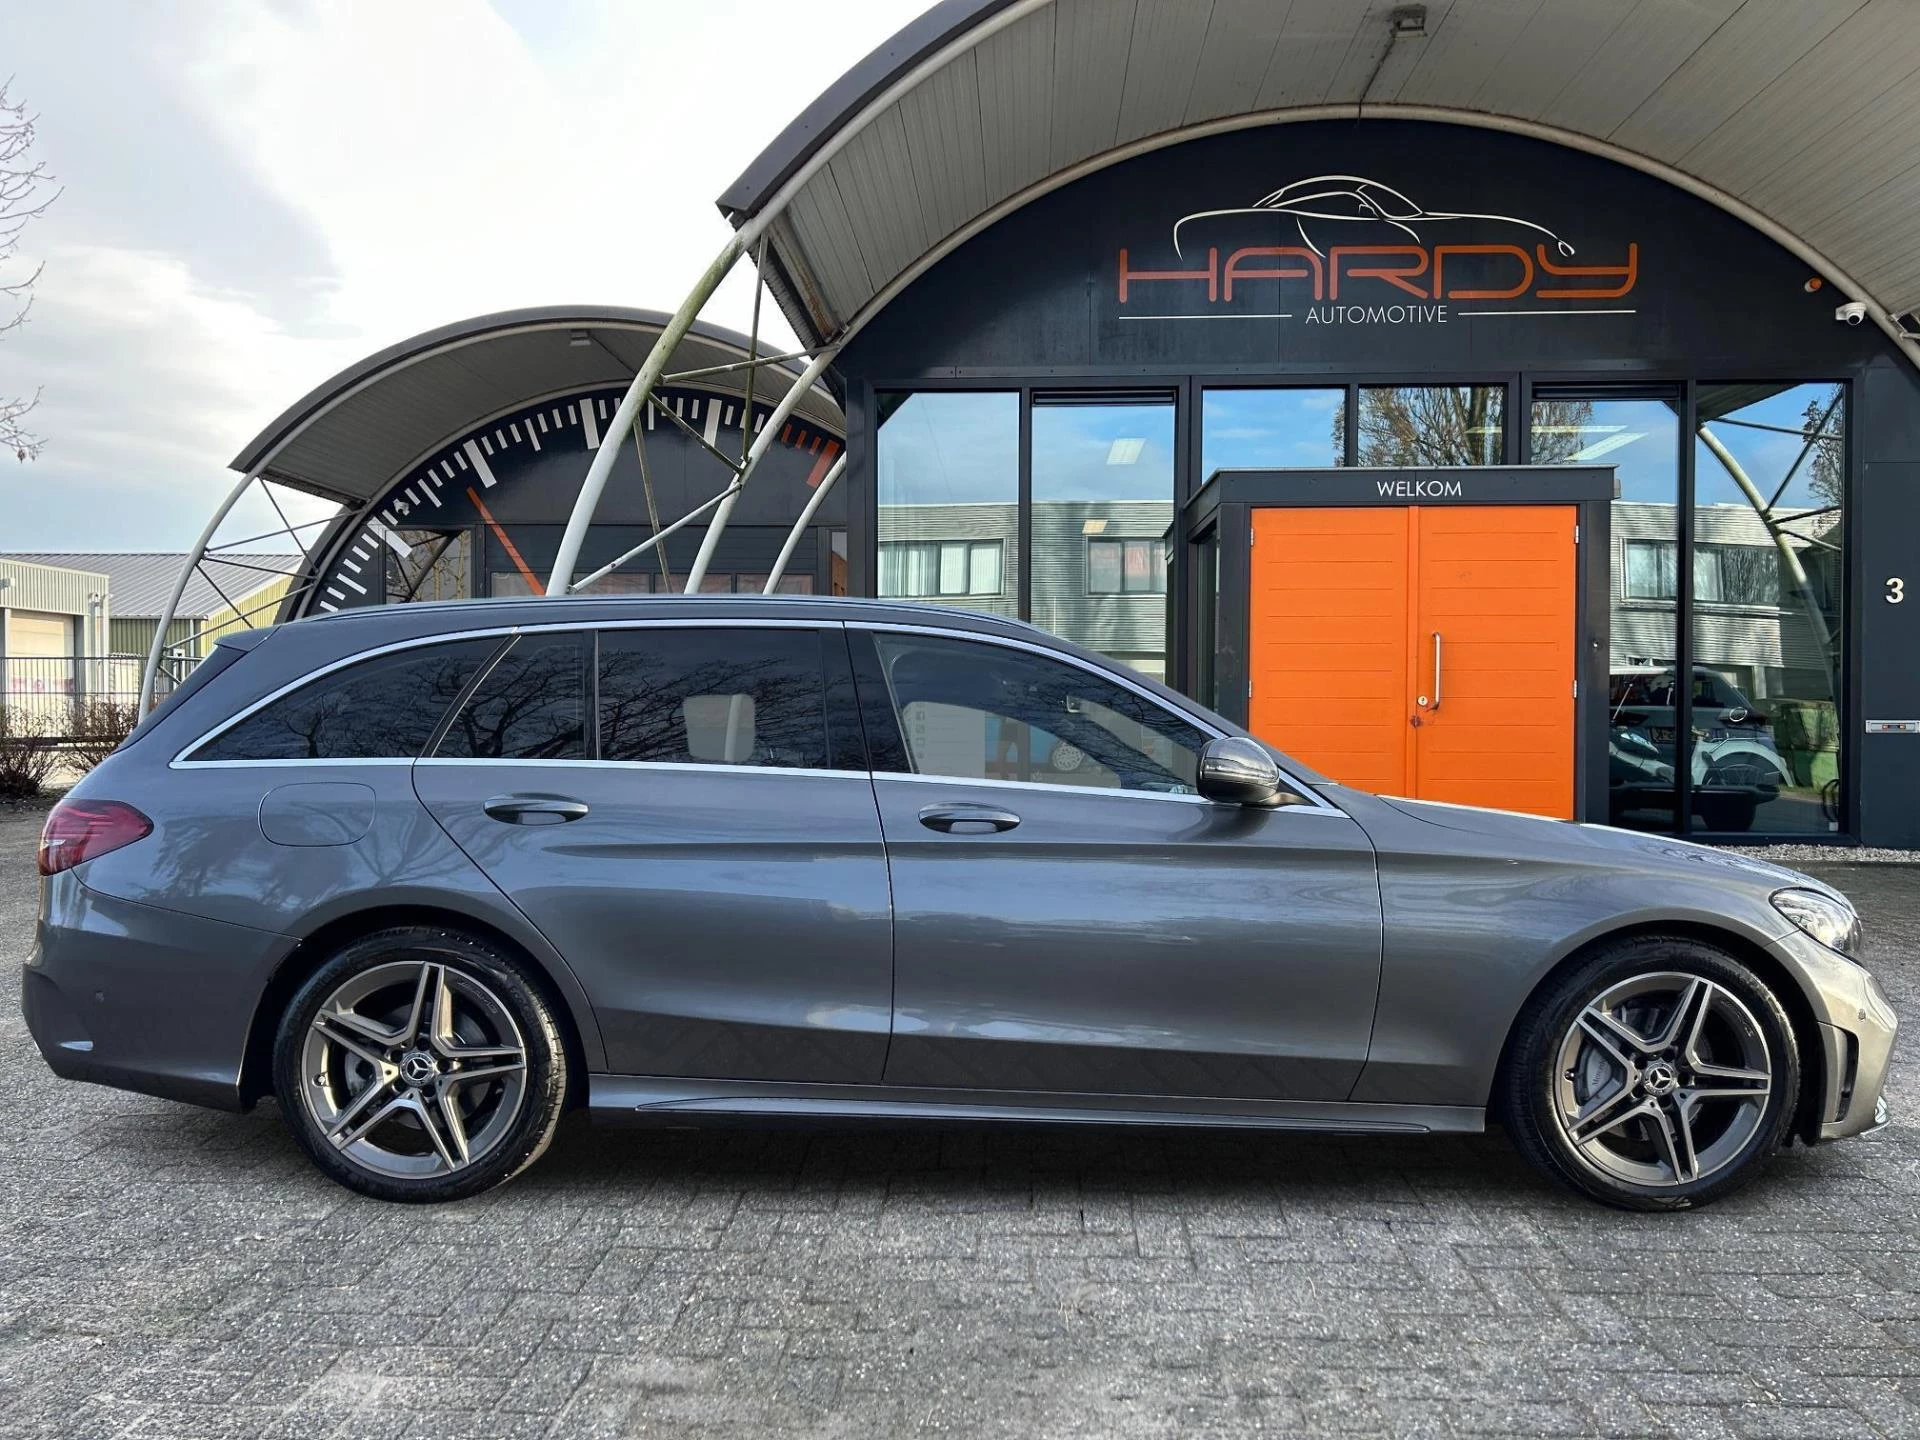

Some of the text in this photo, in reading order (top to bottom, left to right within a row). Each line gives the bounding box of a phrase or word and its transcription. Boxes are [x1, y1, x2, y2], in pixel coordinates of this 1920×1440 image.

[1119, 242, 1638, 302] HARDY
[1305, 304, 1448, 324] AUTOMOTIVE
[1376, 480, 1462, 497] WELKOM
[1886, 577, 1904, 604] 3
